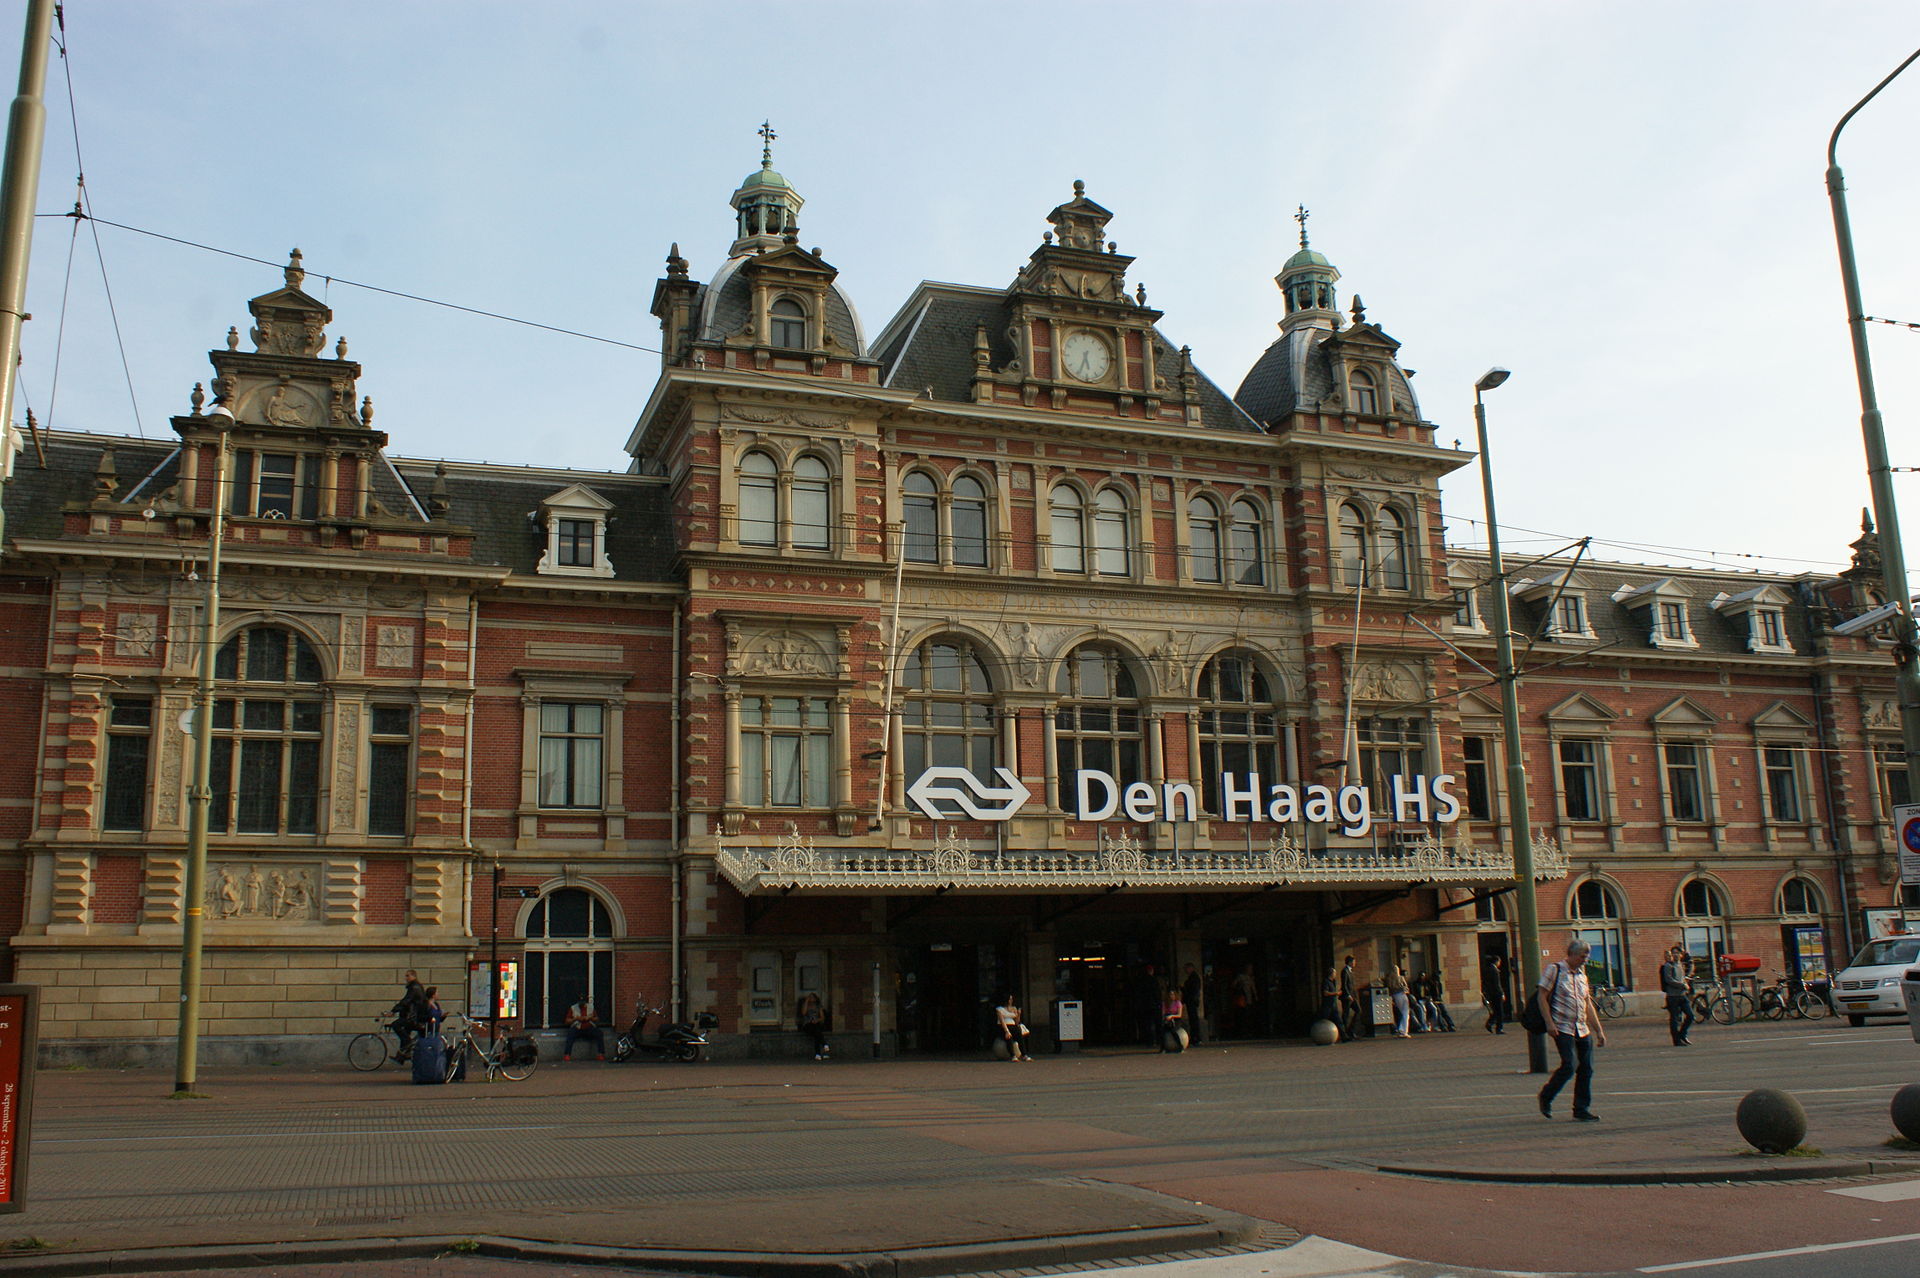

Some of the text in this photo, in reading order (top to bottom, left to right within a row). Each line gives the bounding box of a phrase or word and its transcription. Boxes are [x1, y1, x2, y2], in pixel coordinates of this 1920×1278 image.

[1076, 768, 1461, 837] Den Haag HS
[5, 1083, 14, 1093] 28
[1, 1094, 11, 1132] september
[0, 1146, 8, 1176] oktober
